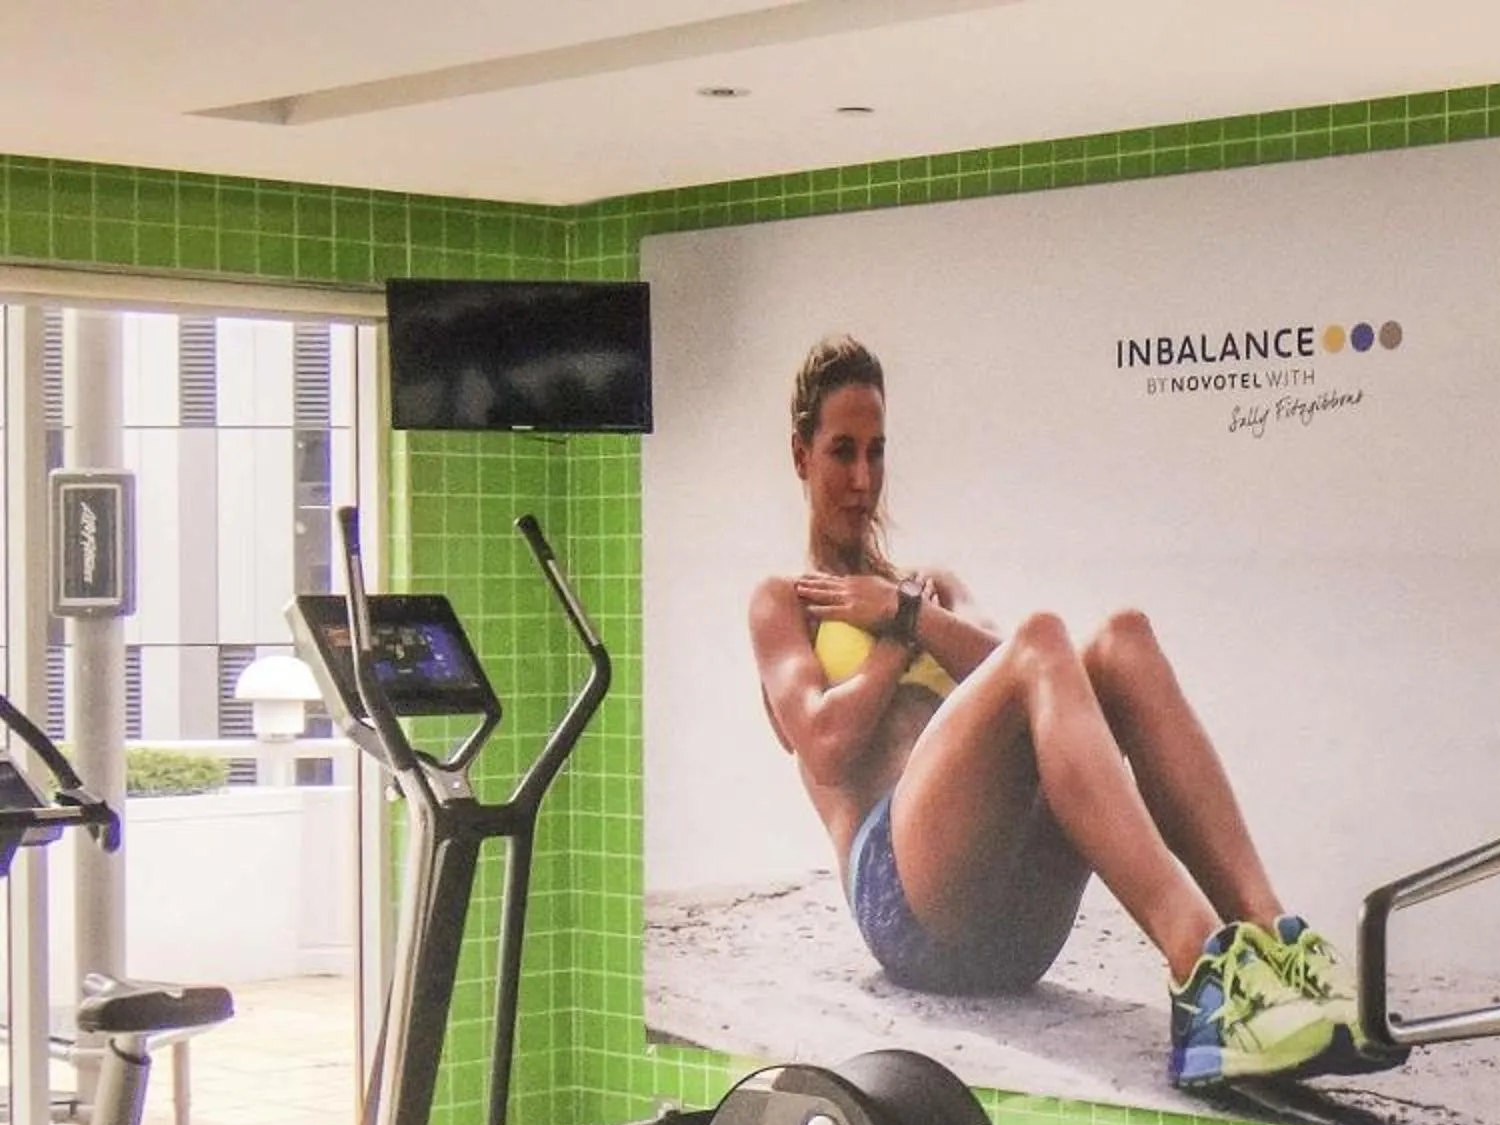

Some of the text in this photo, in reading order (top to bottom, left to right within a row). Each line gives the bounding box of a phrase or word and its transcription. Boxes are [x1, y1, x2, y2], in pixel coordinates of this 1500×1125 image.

[1117, 327, 1314, 368] INBALANCE
[1171, 373, 1262, 393] NOVOTEL
[1265, 369, 1315, 388] WITH
